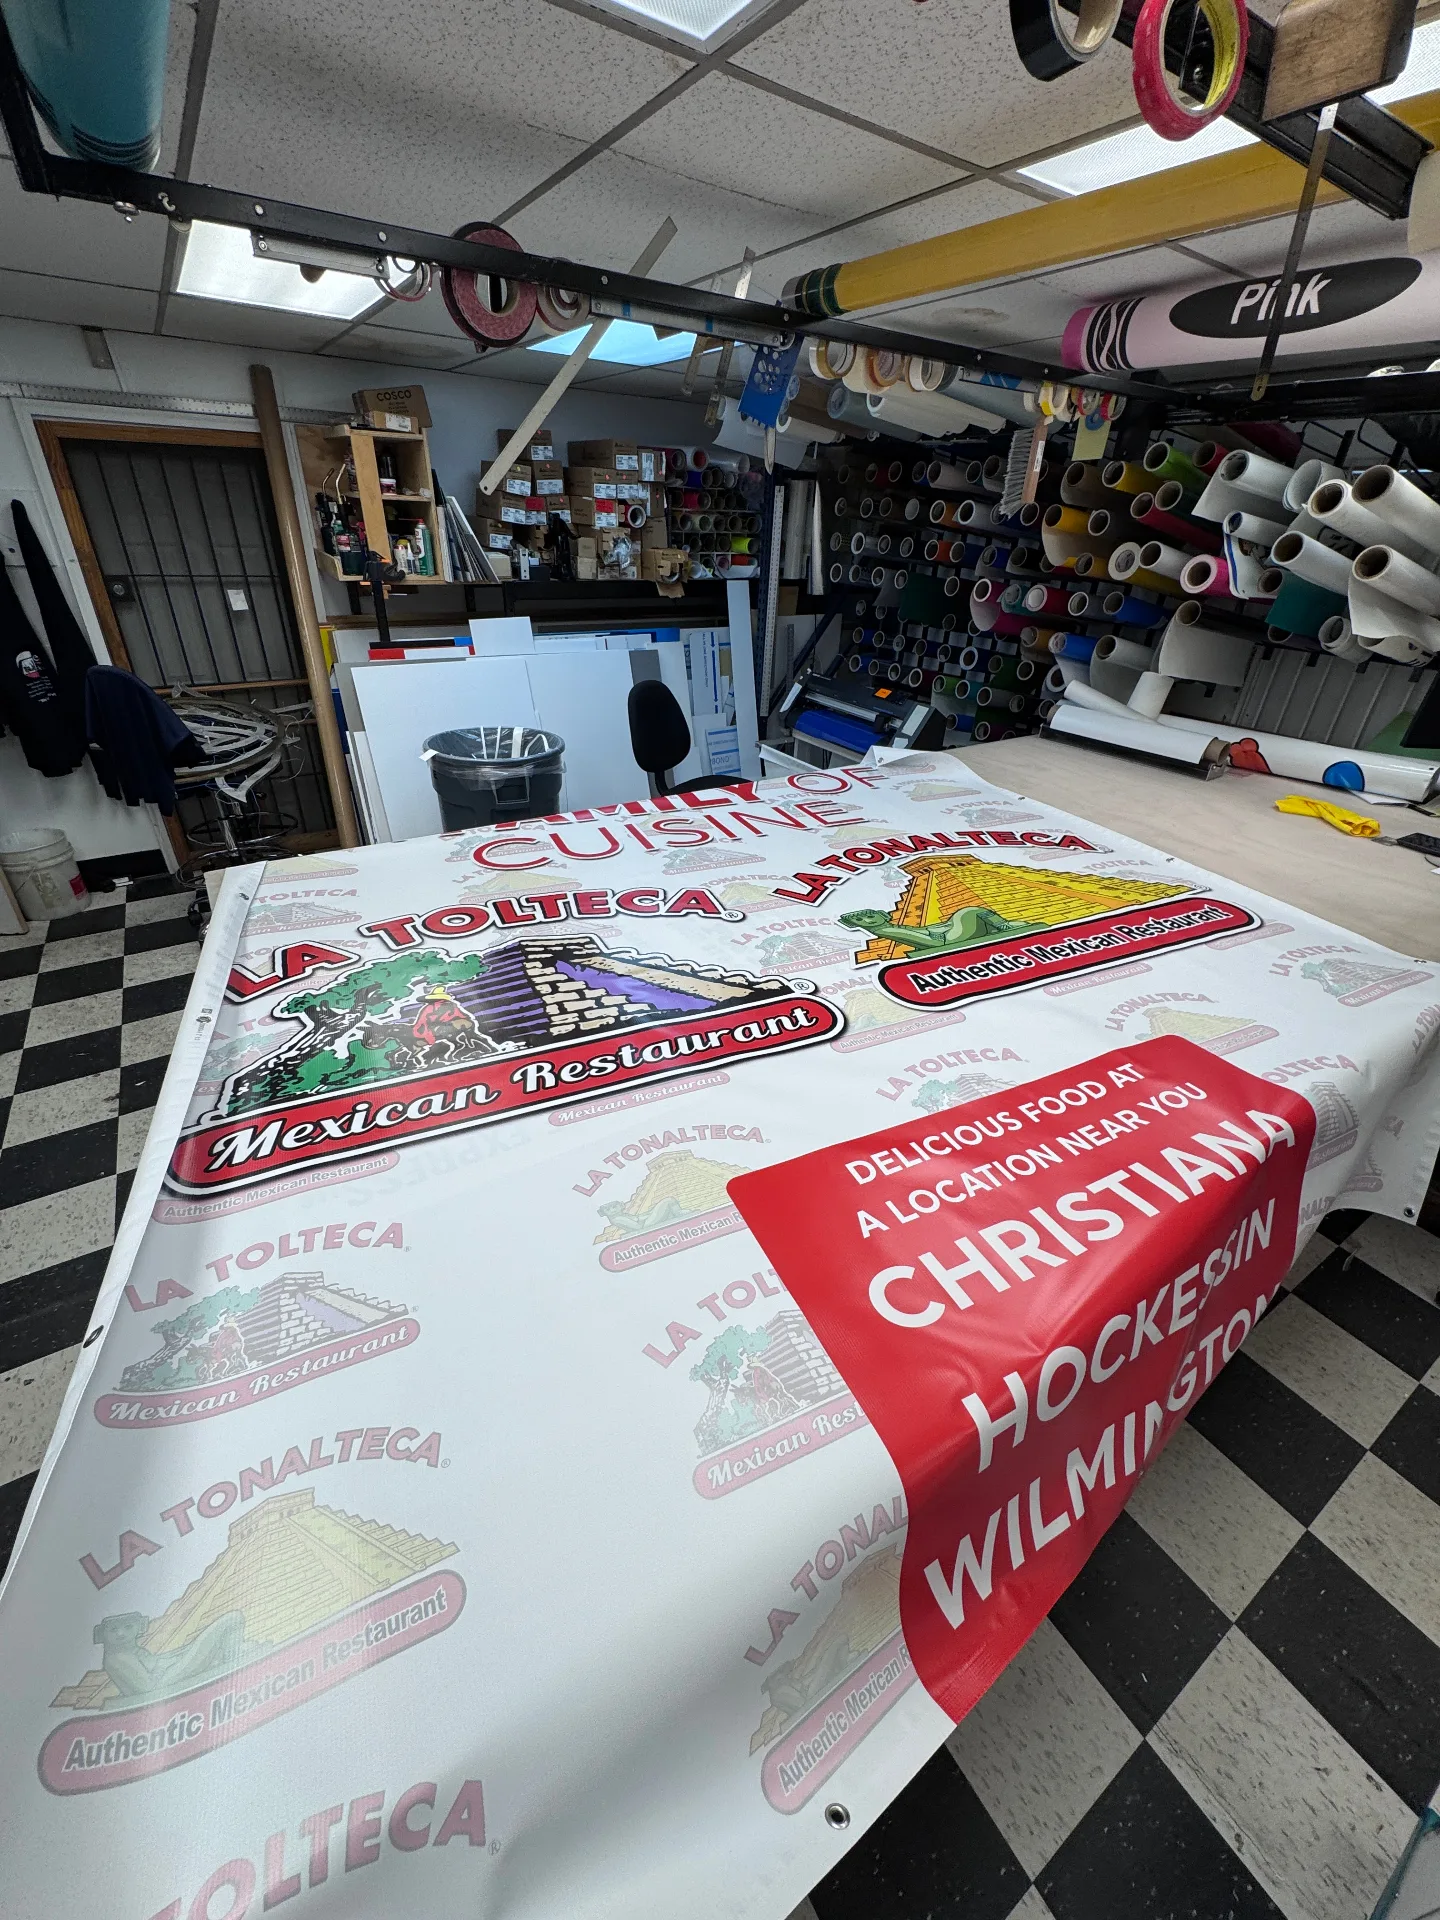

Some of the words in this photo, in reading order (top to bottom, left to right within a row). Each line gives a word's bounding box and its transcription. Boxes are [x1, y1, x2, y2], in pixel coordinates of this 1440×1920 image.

[1230, 272, 1332, 325] Pink
[376, 390, 412, 402] COSCO
[786, 766, 888, 794] OF
[472, 799, 868, 869] CUISINE
[772, 871, 842, 906] LA
[813, 829, 1100, 874] TONALTECA
[225, 941, 353, 1001] LA
[361, 886, 728, 950] TOLTECA
[908, 951, 1034, 994] Authentic
[1024, 931, 1126, 965] Mexican
[1117, 903, 1234, 940] Restaurant
[203, 1081, 501, 1173] Mexican
[512, 1004, 819, 1094] Restaurant
[558, 1100, 629, 1123] Mexican
[631, 1073, 725, 1104] Restaurant
[875, 1076, 913, 1102] LA
[903, 1047, 1024, 1079] TOLTECA
[572, 1168, 614, 1198] LA
[603, 1123, 768, 1171] TONALTECA
[844, 1110, 1023, 1186] DELICIOUS
[1023, 1079, 1109, 1127] FOOD
[1102, 1062, 1147, 1097] AT
[855, 1208, 891, 1239] A
[885, 1143, 1064, 1226] LOCATION
[1055, 1106, 1151, 1157] NEAR
[1136, 1081, 1208, 1122] YOU
[163, 1195, 246, 1218] Authentic
[246, 1177, 308, 1202] Mexican
[310, 1155, 389, 1185] Restaurant
[867, 1107, 1297, 1330] CHRISTIANA
[124, 1277, 195, 1314] LA
[205, 1221, 404, 1283] TOLTECA
[612, 1234, 679, 1265] Authentic
[678, 1215, 733, 1242] Mexican
[108, 1391, 242, 1422] Mexican
[248, 1323, 411, 1397] Restaurant
[641, 1319, 704, 1370] LA
[707, 1428, 812, 1490] Mexican
[78, 1528, 165, 1591] LA
[159, 1426, 443, 1538] TONALTECA
[743, 1607, 801, 1668] LA
[60, 1711, 205, 1774] Authentic
[207, 1660, 316, 1731] Mexican
[320, 1585, 449, 1673] Restaurant
[775, 1711, 850, 1797] Authentic
[842, 1660, 903, 1726] Mexican
